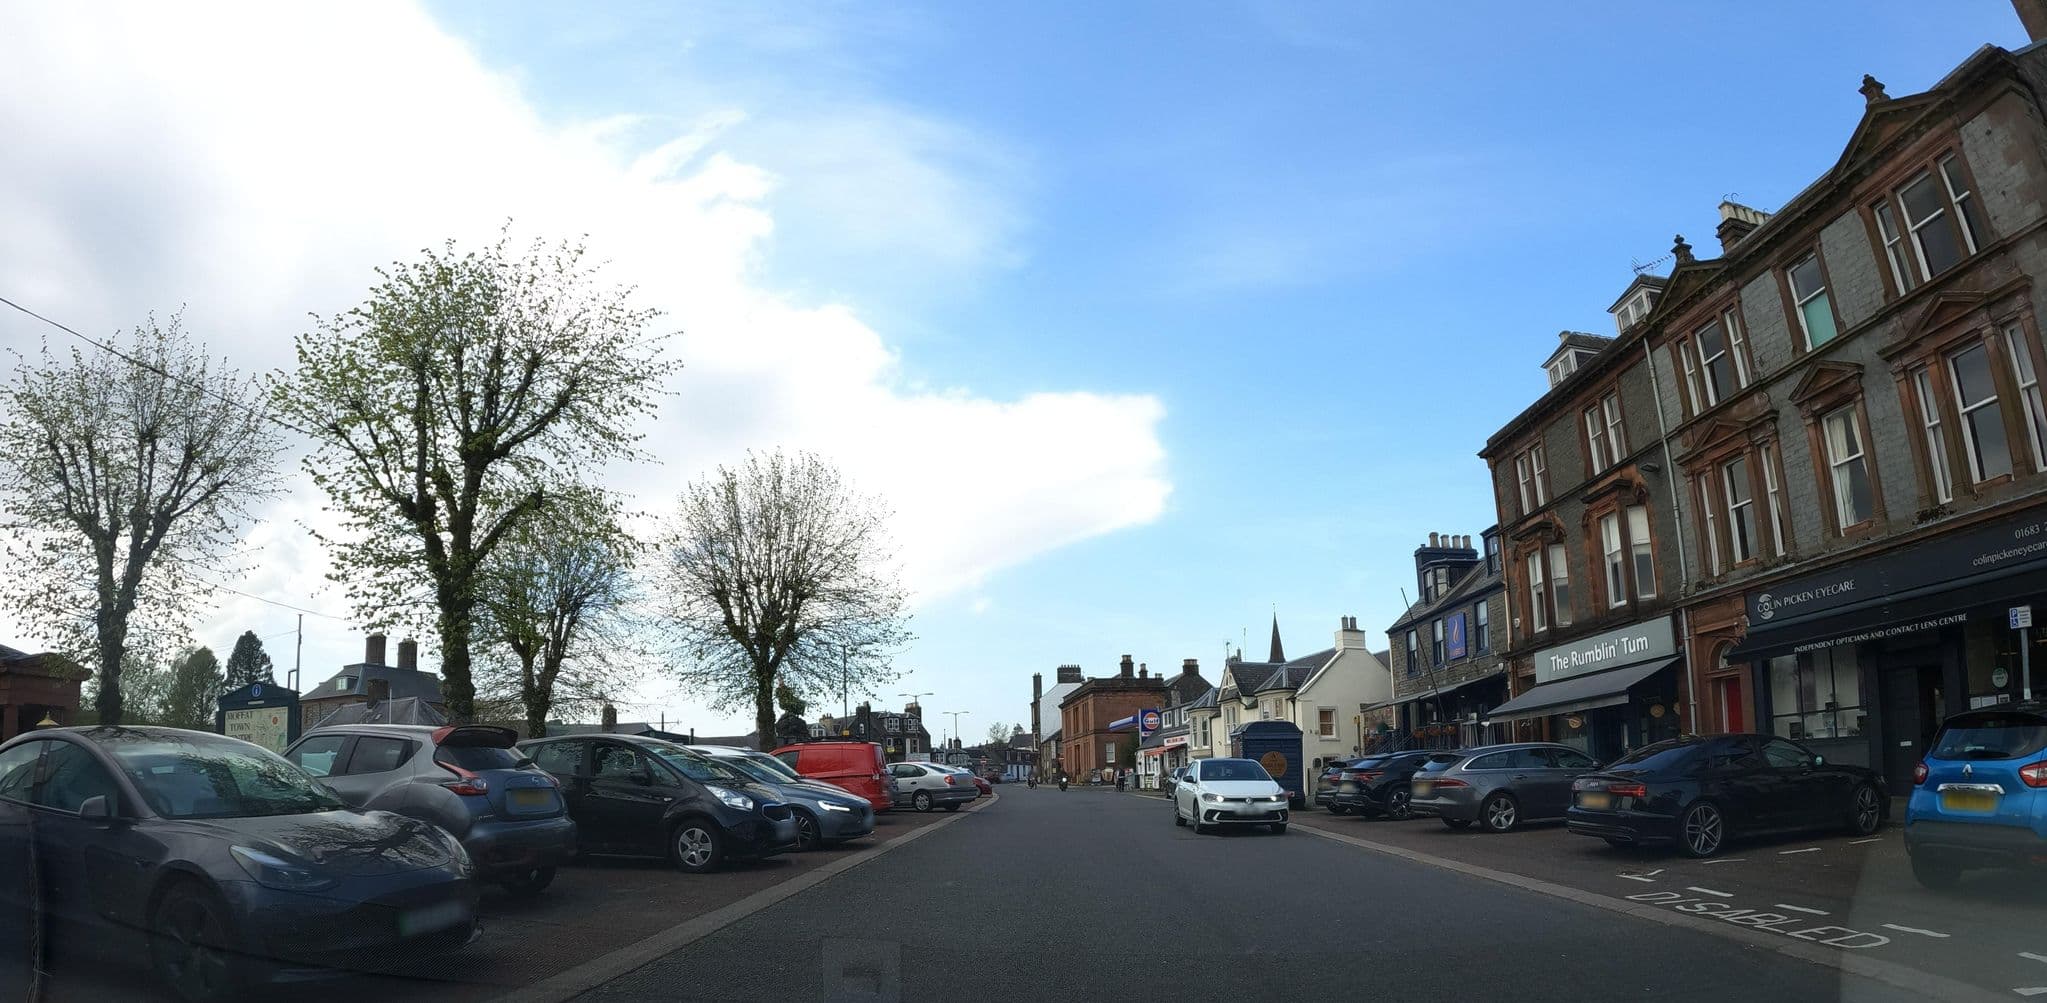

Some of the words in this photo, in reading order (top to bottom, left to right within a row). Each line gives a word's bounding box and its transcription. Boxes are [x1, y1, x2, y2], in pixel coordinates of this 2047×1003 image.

[2015, 525, 2040, 539] 01683
[1757, 601, 1782, 613] COLIN
[1783, 590, 1814, 606] PICKEN
[1815, 579, 1856, 599] EYECARE
[1794, 639, 1835, 653] INDEPENDENT
[1835, 630, 1869, 645] OPTICIANS
[1869, 628, 1885, 640] AND
[1885, 622, 1919, 637] CONTACT
[1920, 619, 1938, 630] LENS
[1938, 612, 1968, 627] CENTRE
[1550, 655, 1569, 671] The
[1571, 640, 1619, 667] Rumblin'
[1621, 635, 1649, 654] Tum
[1625, 892, 1890, 949] DISABLED
